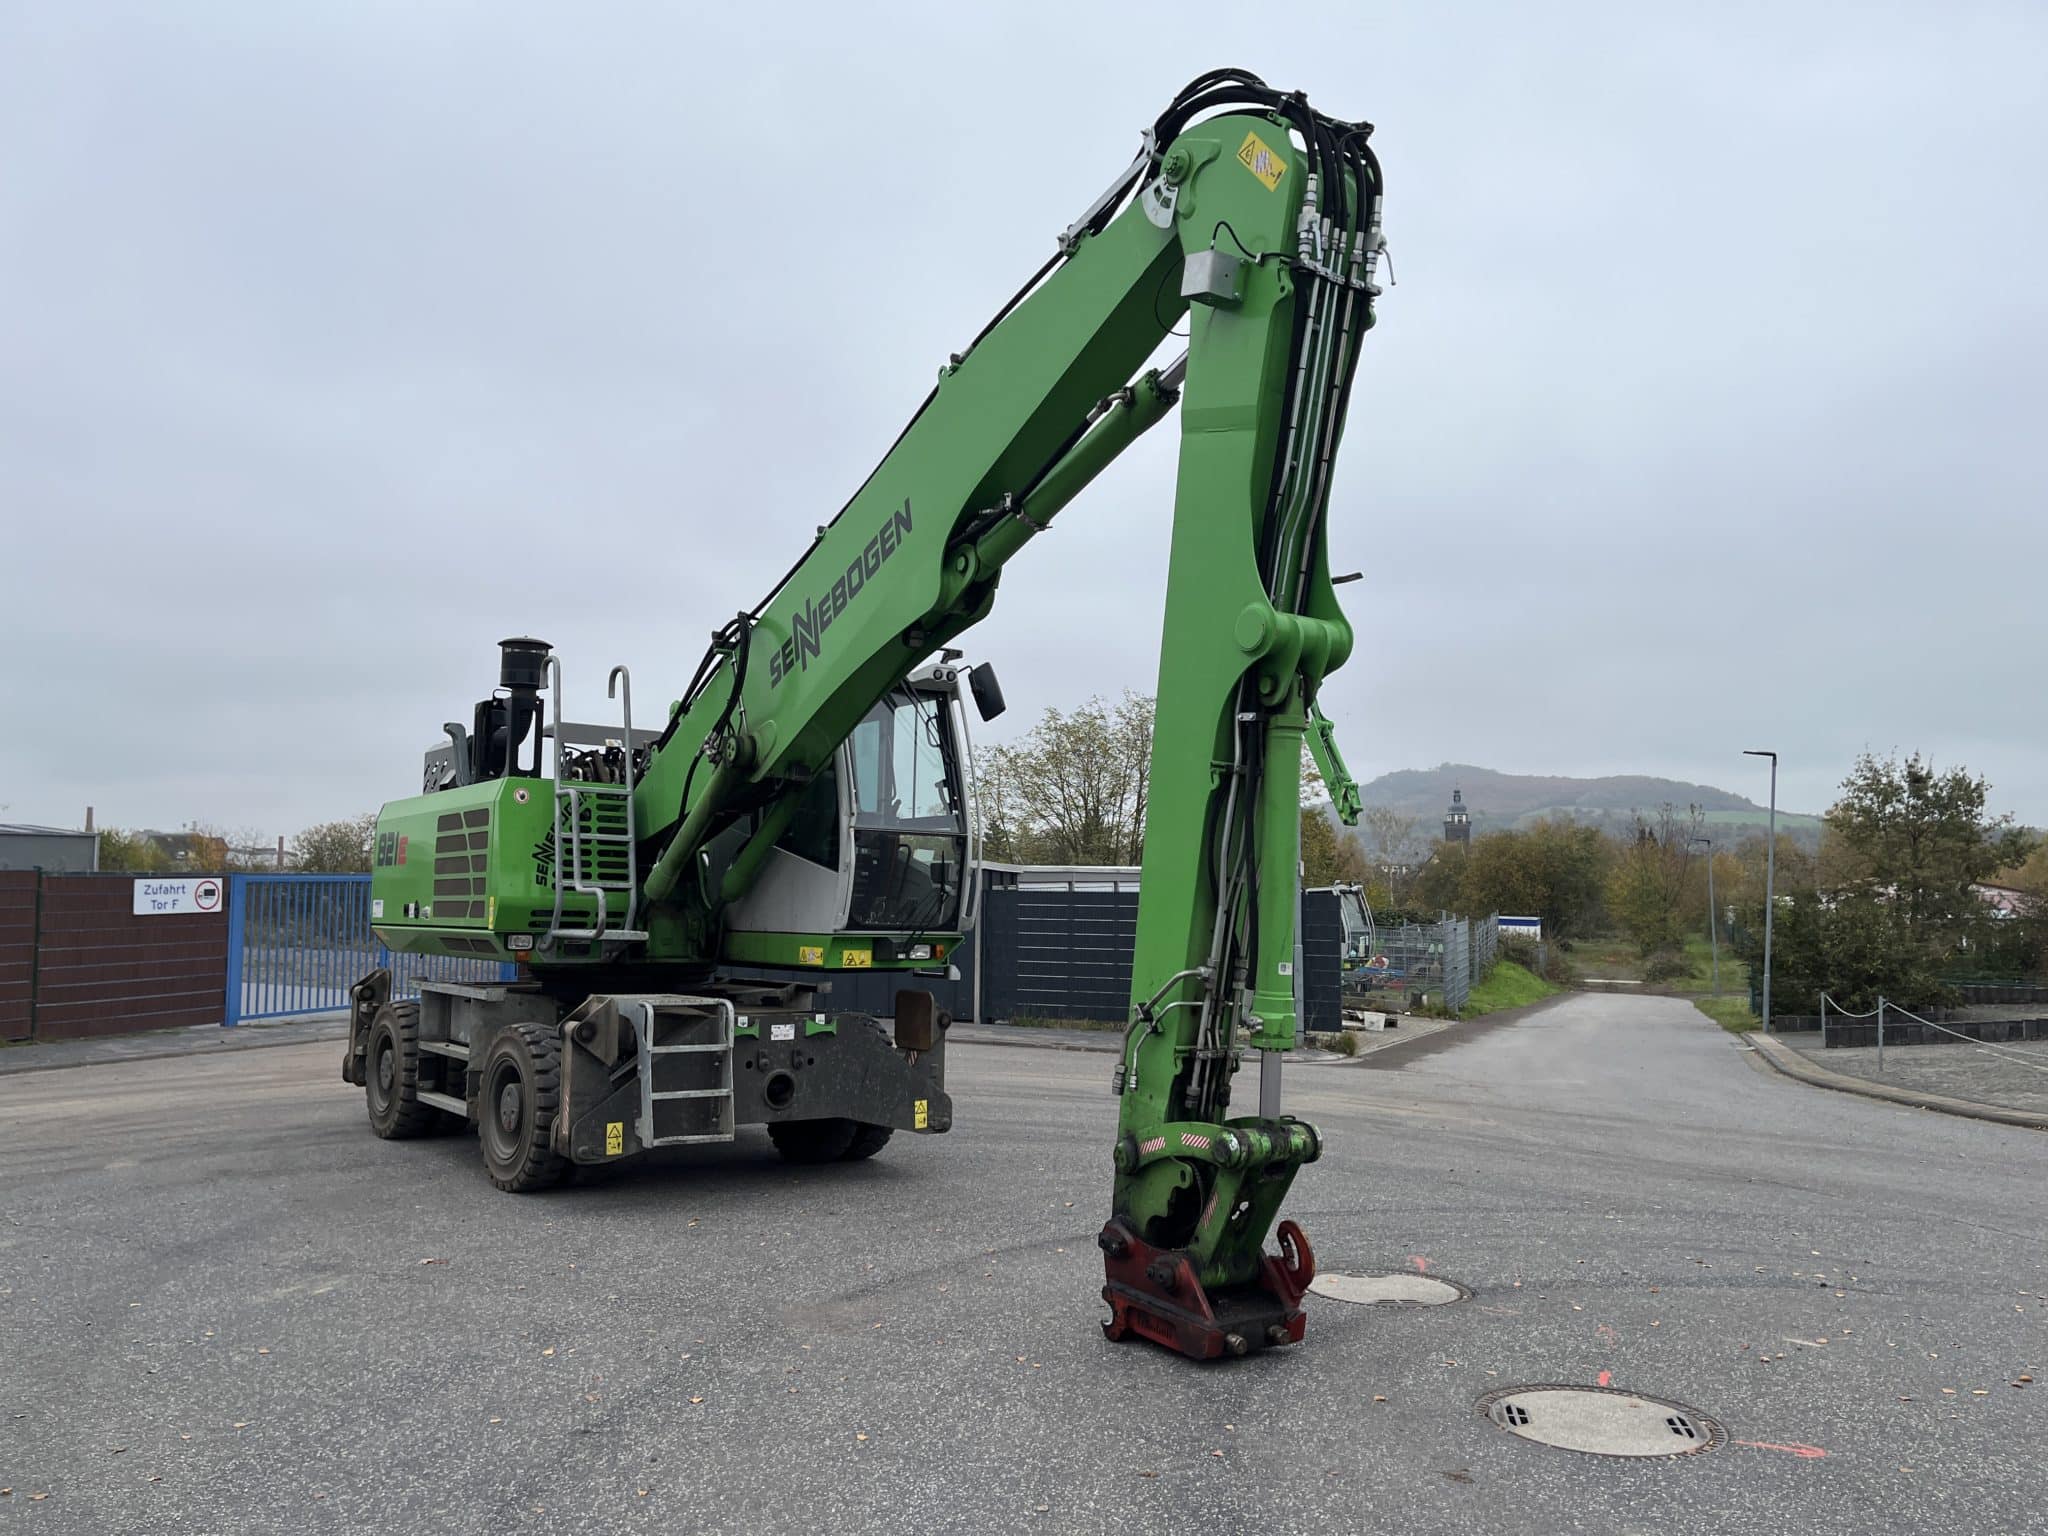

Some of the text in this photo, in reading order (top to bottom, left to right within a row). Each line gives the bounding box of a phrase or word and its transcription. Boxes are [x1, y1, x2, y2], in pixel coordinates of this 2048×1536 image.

[769, 496, 913, 690] SENNEBOGEN
[144, 884, 186, 896] Zufahrt
[151, 899, 180, 910] Tor F
